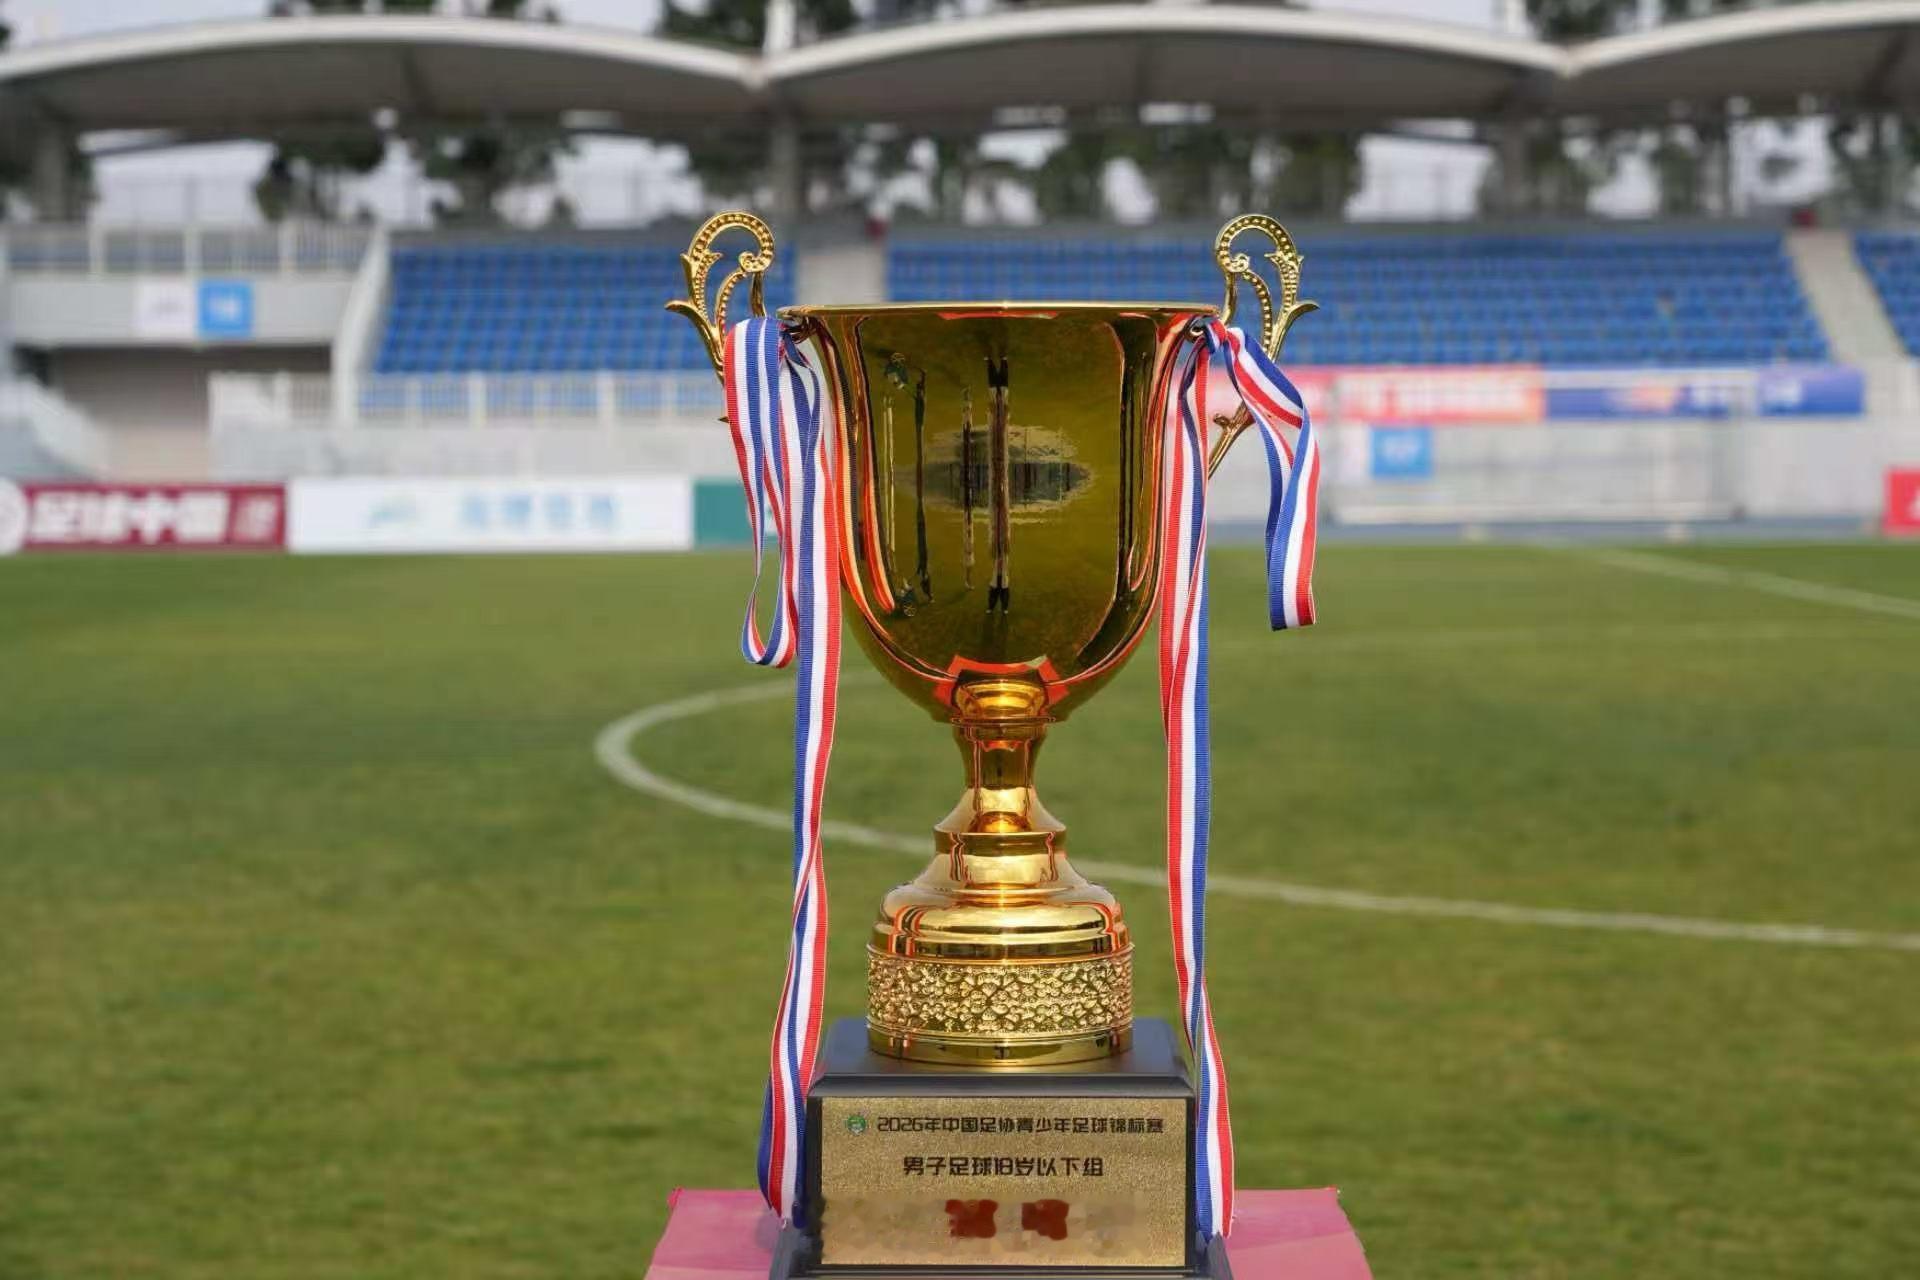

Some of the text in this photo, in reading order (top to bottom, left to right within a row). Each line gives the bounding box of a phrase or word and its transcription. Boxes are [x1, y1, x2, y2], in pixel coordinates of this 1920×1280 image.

[877, 1116, 1164, 1134] 2026年中国足协青少年足球锦标赛
[903, 1156, 1104, 1177] 男子足球18岁以下组
